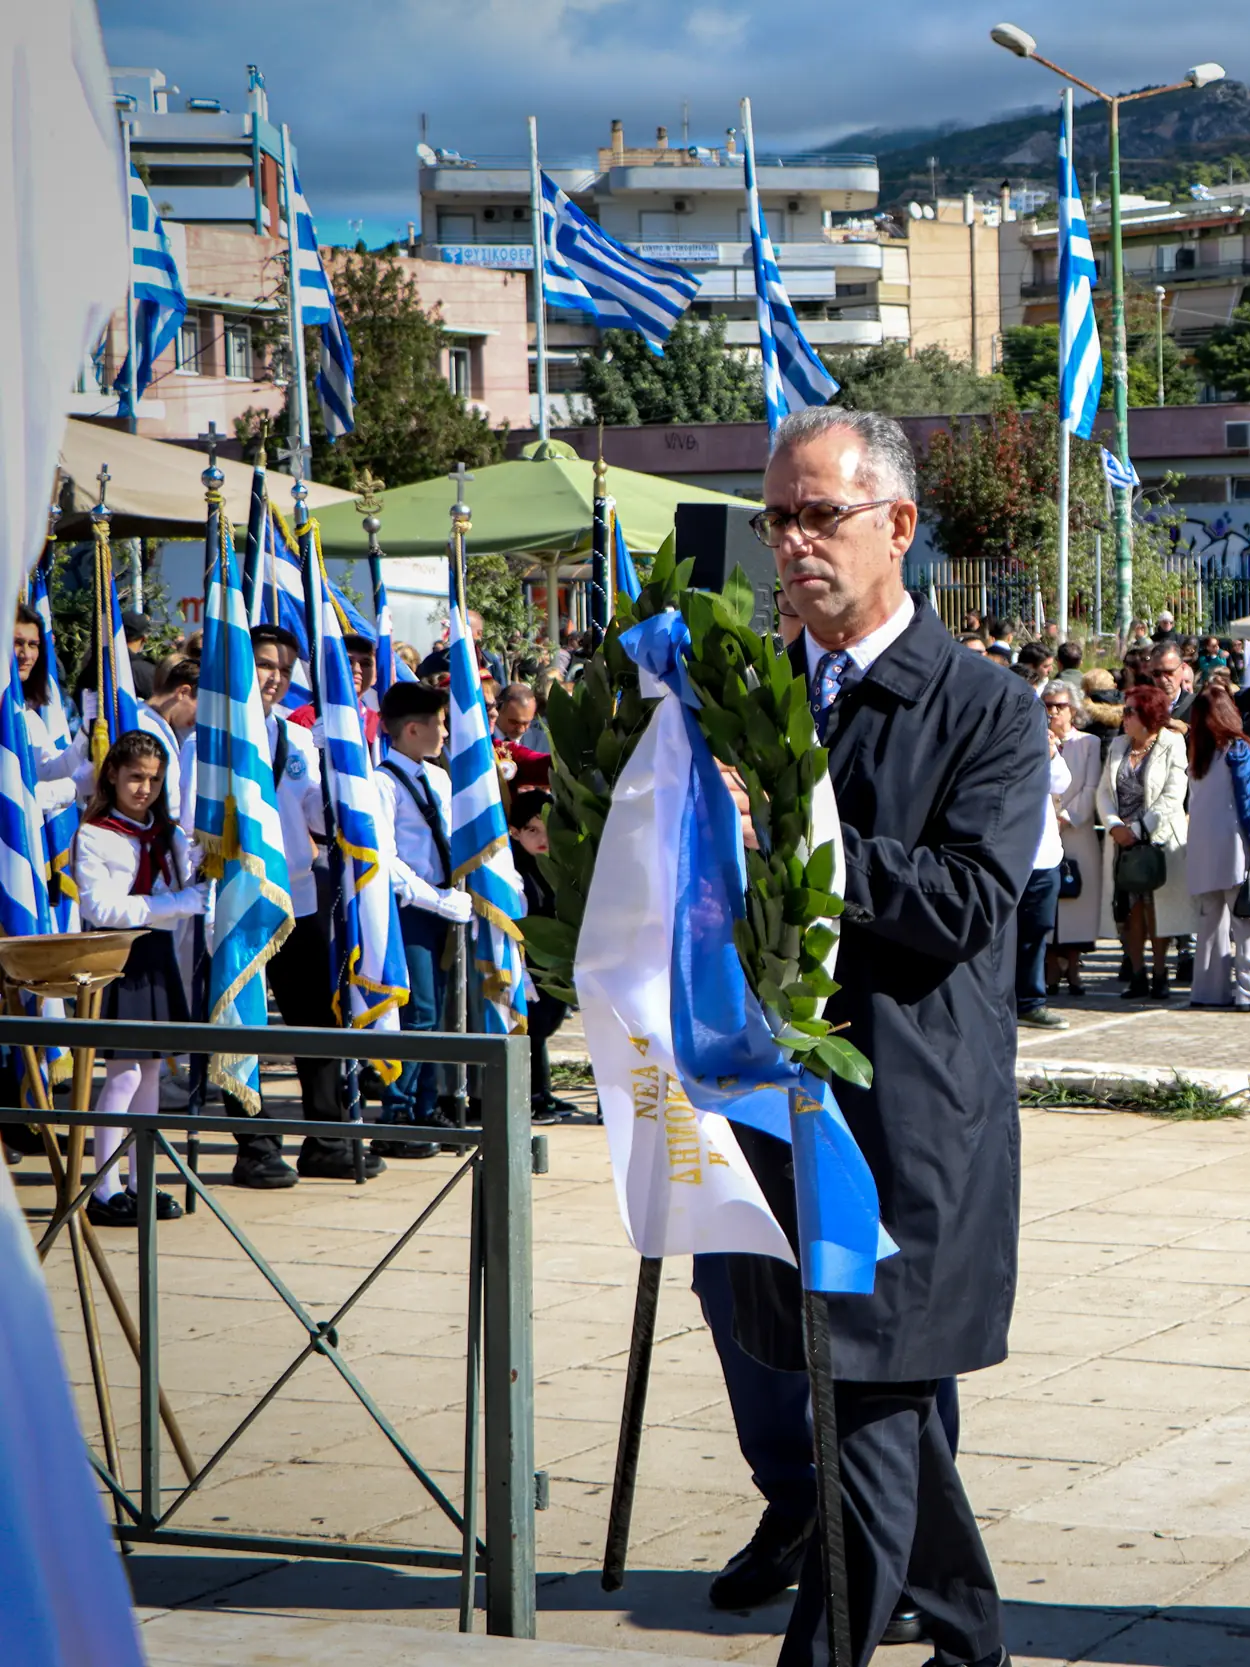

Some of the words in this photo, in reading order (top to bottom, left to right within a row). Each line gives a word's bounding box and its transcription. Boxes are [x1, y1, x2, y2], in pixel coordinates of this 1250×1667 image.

[464, 248, 532, 261] ΦΥΣΙΚΟΘΕΡ
[630, 1064, 659, 1121] ΝΕΑ
[663, 1073, 702, 1185] ΔΗΜΟΚ
